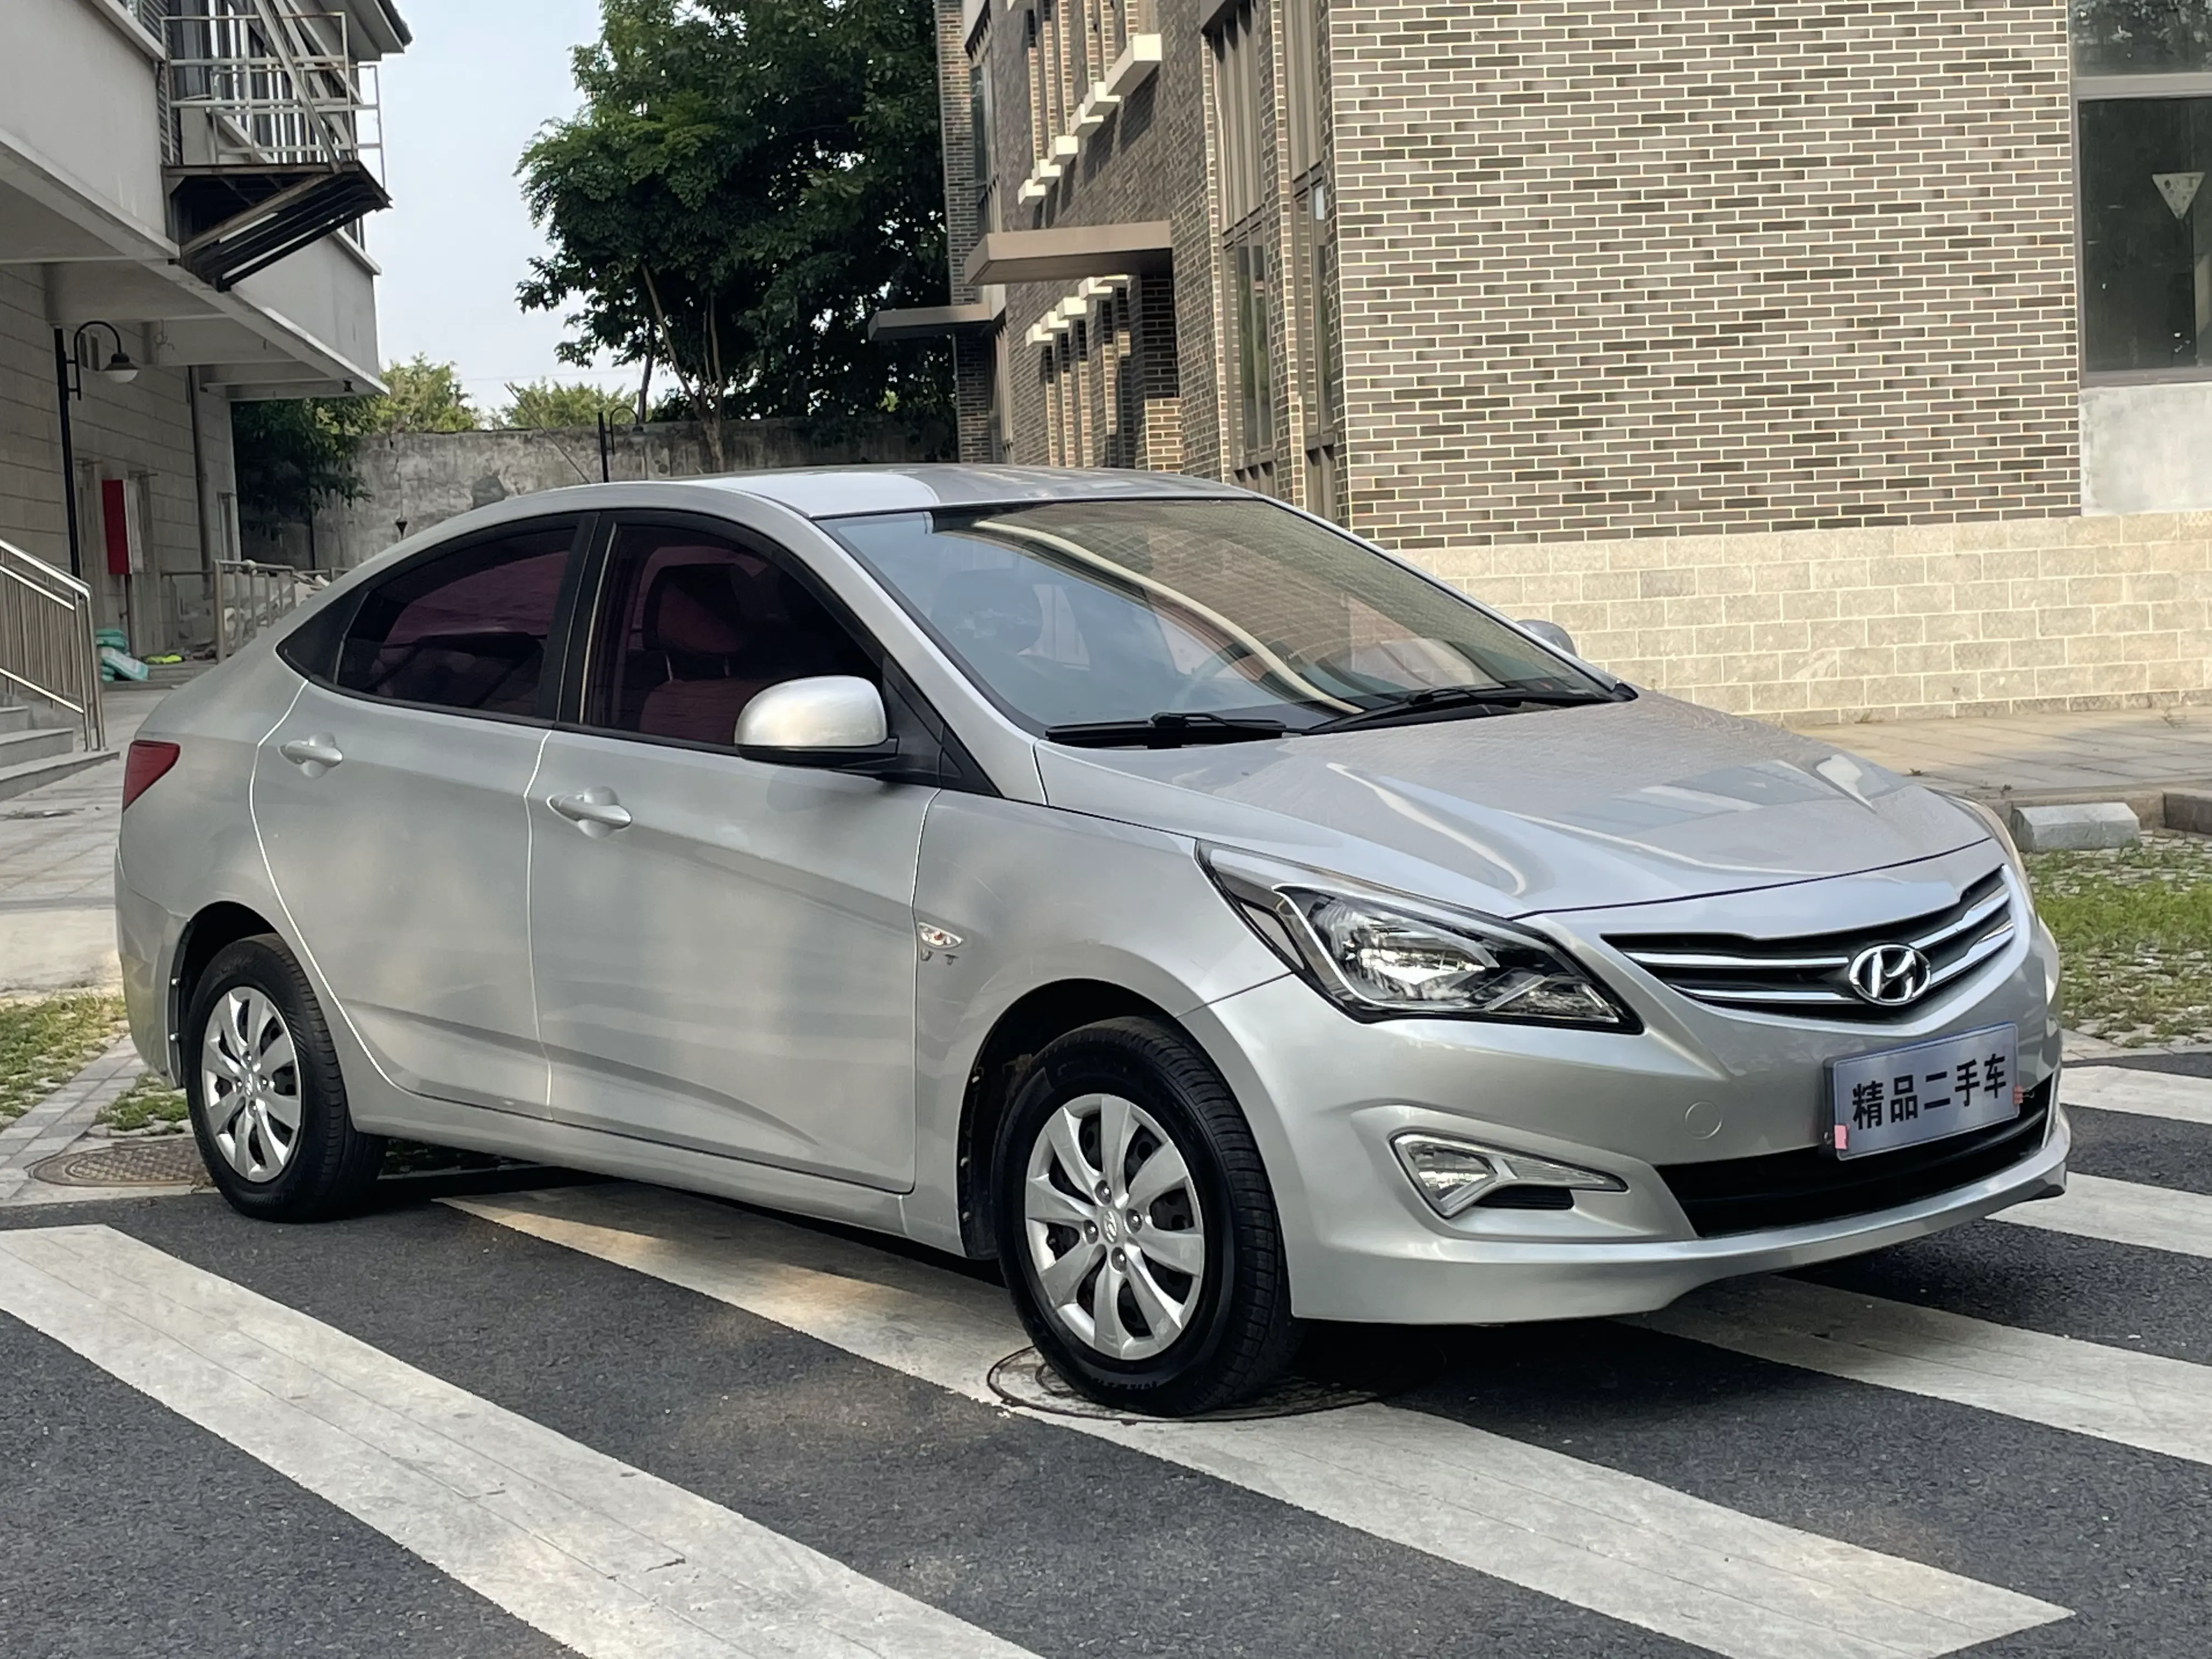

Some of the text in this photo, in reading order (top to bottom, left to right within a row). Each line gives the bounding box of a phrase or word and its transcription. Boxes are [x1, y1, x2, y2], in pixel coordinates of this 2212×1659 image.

[1852, 1053, 2007, 1130] 精品二手车
